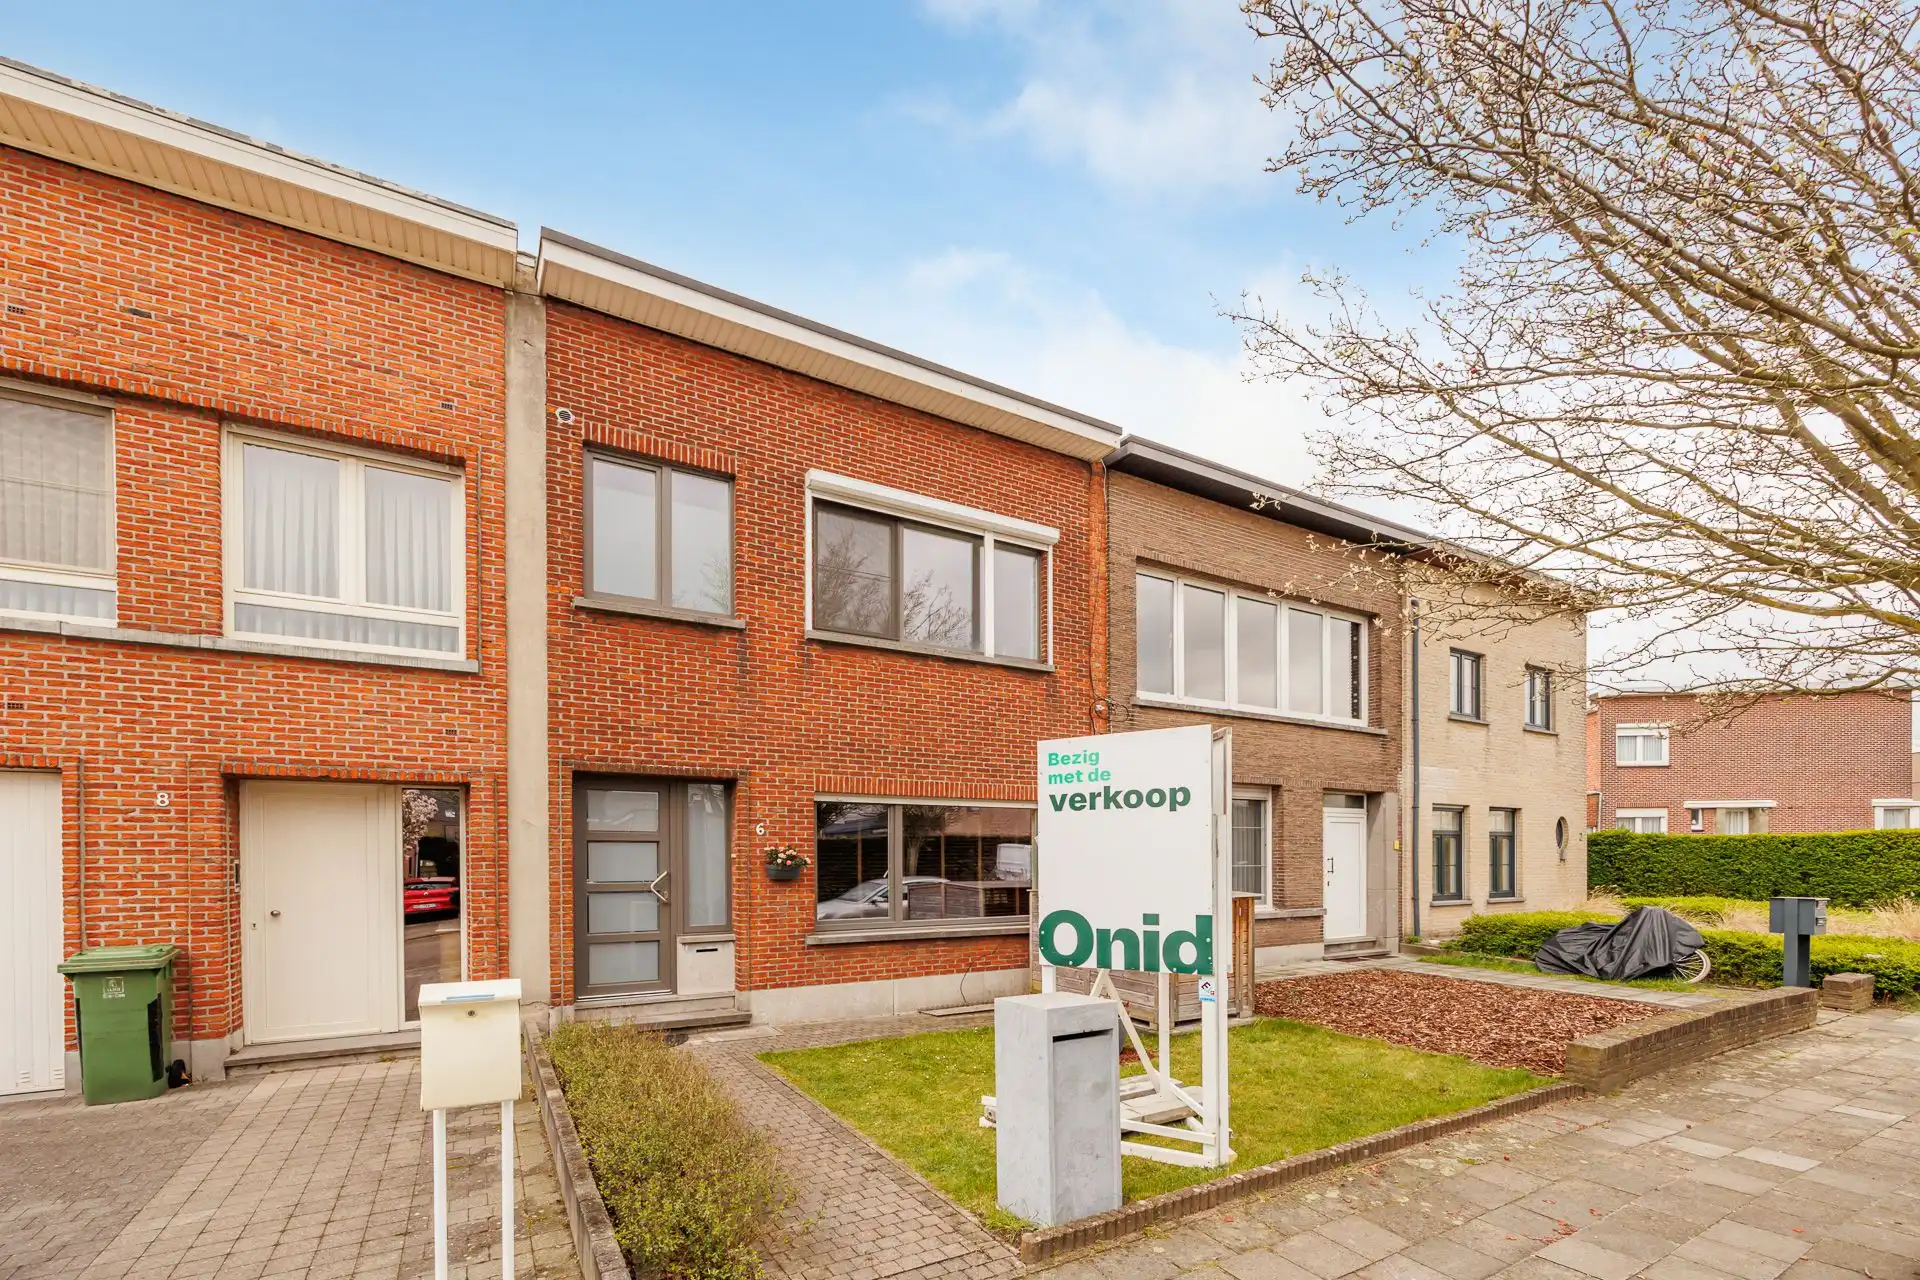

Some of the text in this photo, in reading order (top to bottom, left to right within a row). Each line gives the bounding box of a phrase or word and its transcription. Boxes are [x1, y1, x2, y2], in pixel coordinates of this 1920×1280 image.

[1048, 750, 1100, 766] Bezig
[1048, 767, 1111, 785] met de
[156, 792, 170, 807] 8
[1049, 785, 1191, 812] verkoop
[755, 822, 765, 836] 6
